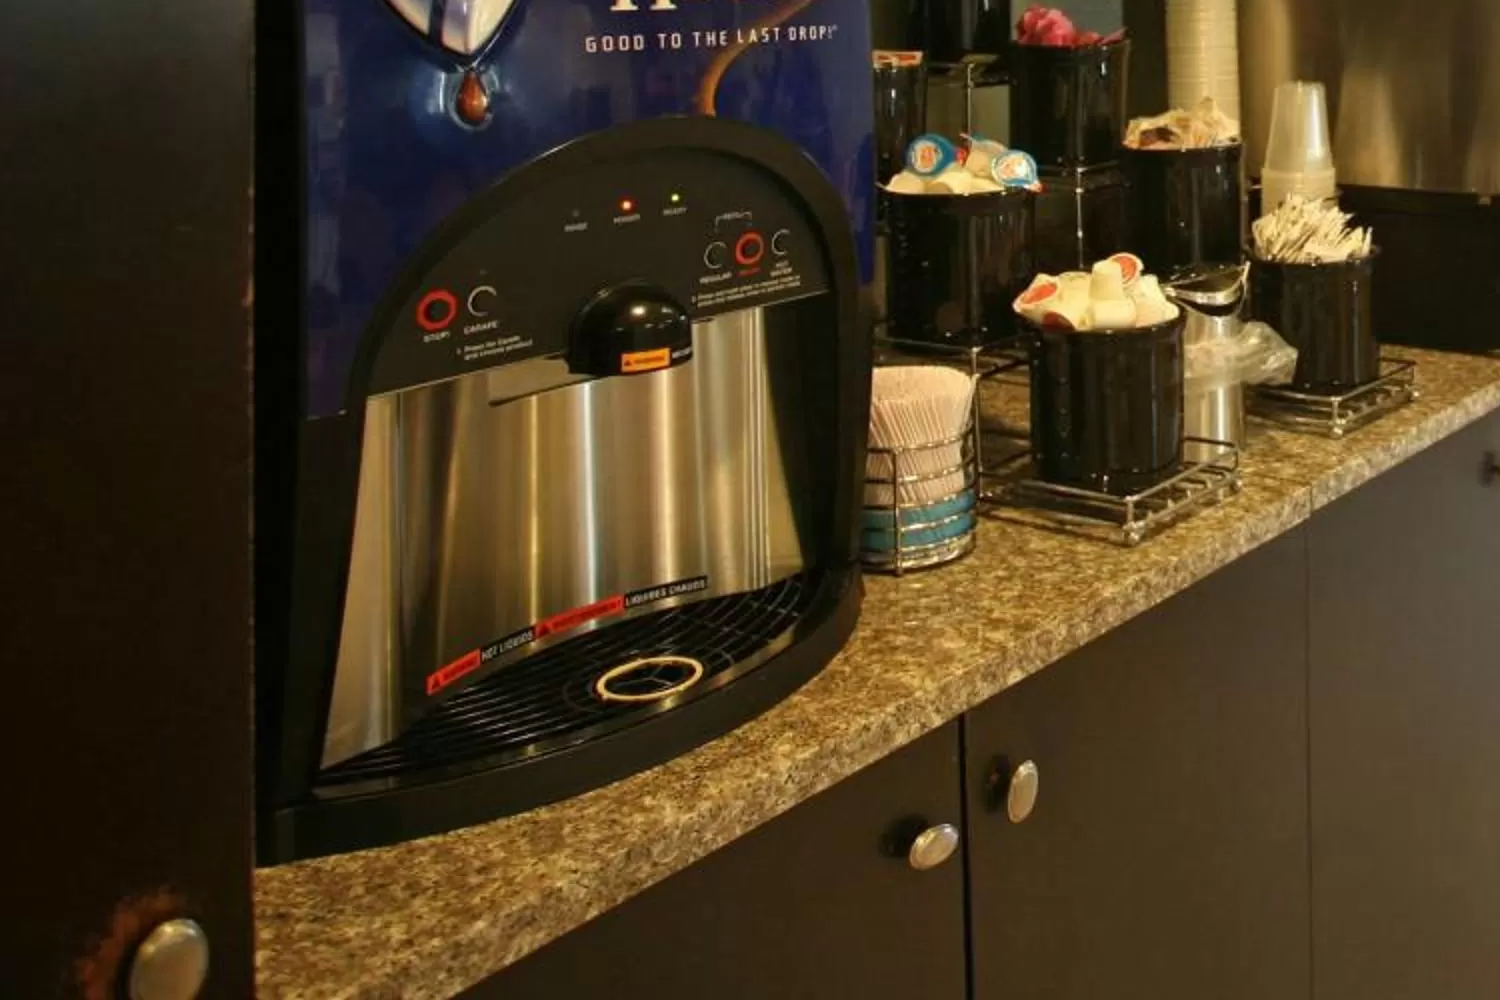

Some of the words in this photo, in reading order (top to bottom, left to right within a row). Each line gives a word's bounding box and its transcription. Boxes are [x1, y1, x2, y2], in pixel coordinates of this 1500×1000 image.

[584, 34, 645, 53] GOOD
[658, 33, 681, 49] TO
[692, 30, 728, 47] THE
[737, 27, 780, 43] LAST
